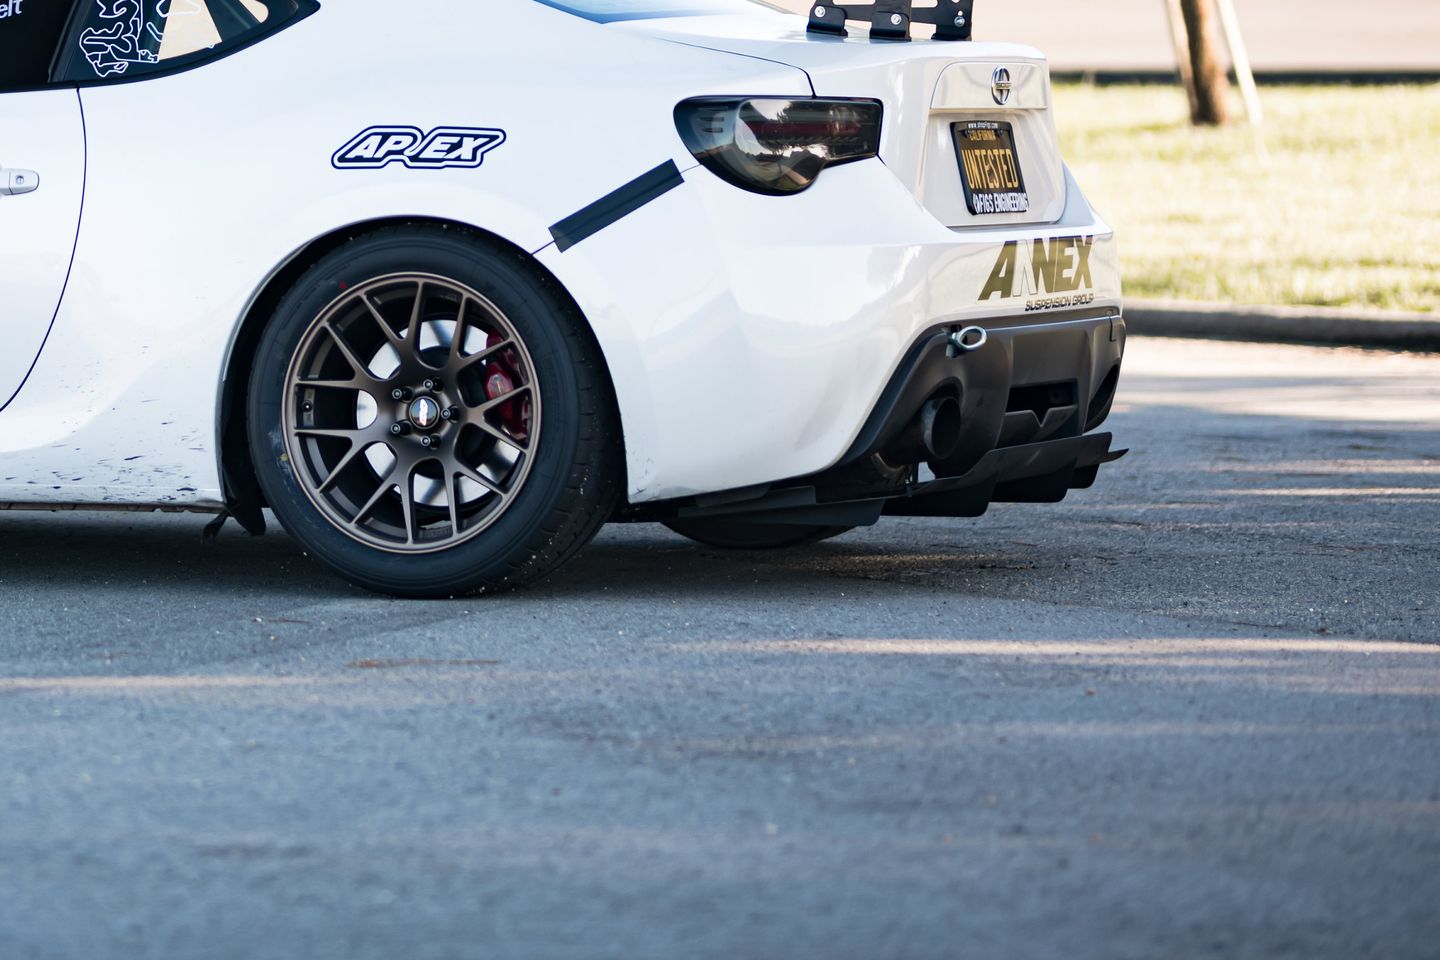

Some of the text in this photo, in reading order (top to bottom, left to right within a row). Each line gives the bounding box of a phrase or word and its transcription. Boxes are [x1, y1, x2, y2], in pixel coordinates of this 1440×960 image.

[961, 149, 1019, 189] UNTESTED
[977, 235, 1094, 300] ANNEX
[1024, 293, 1094, 312] SUSPENSION GROUP
